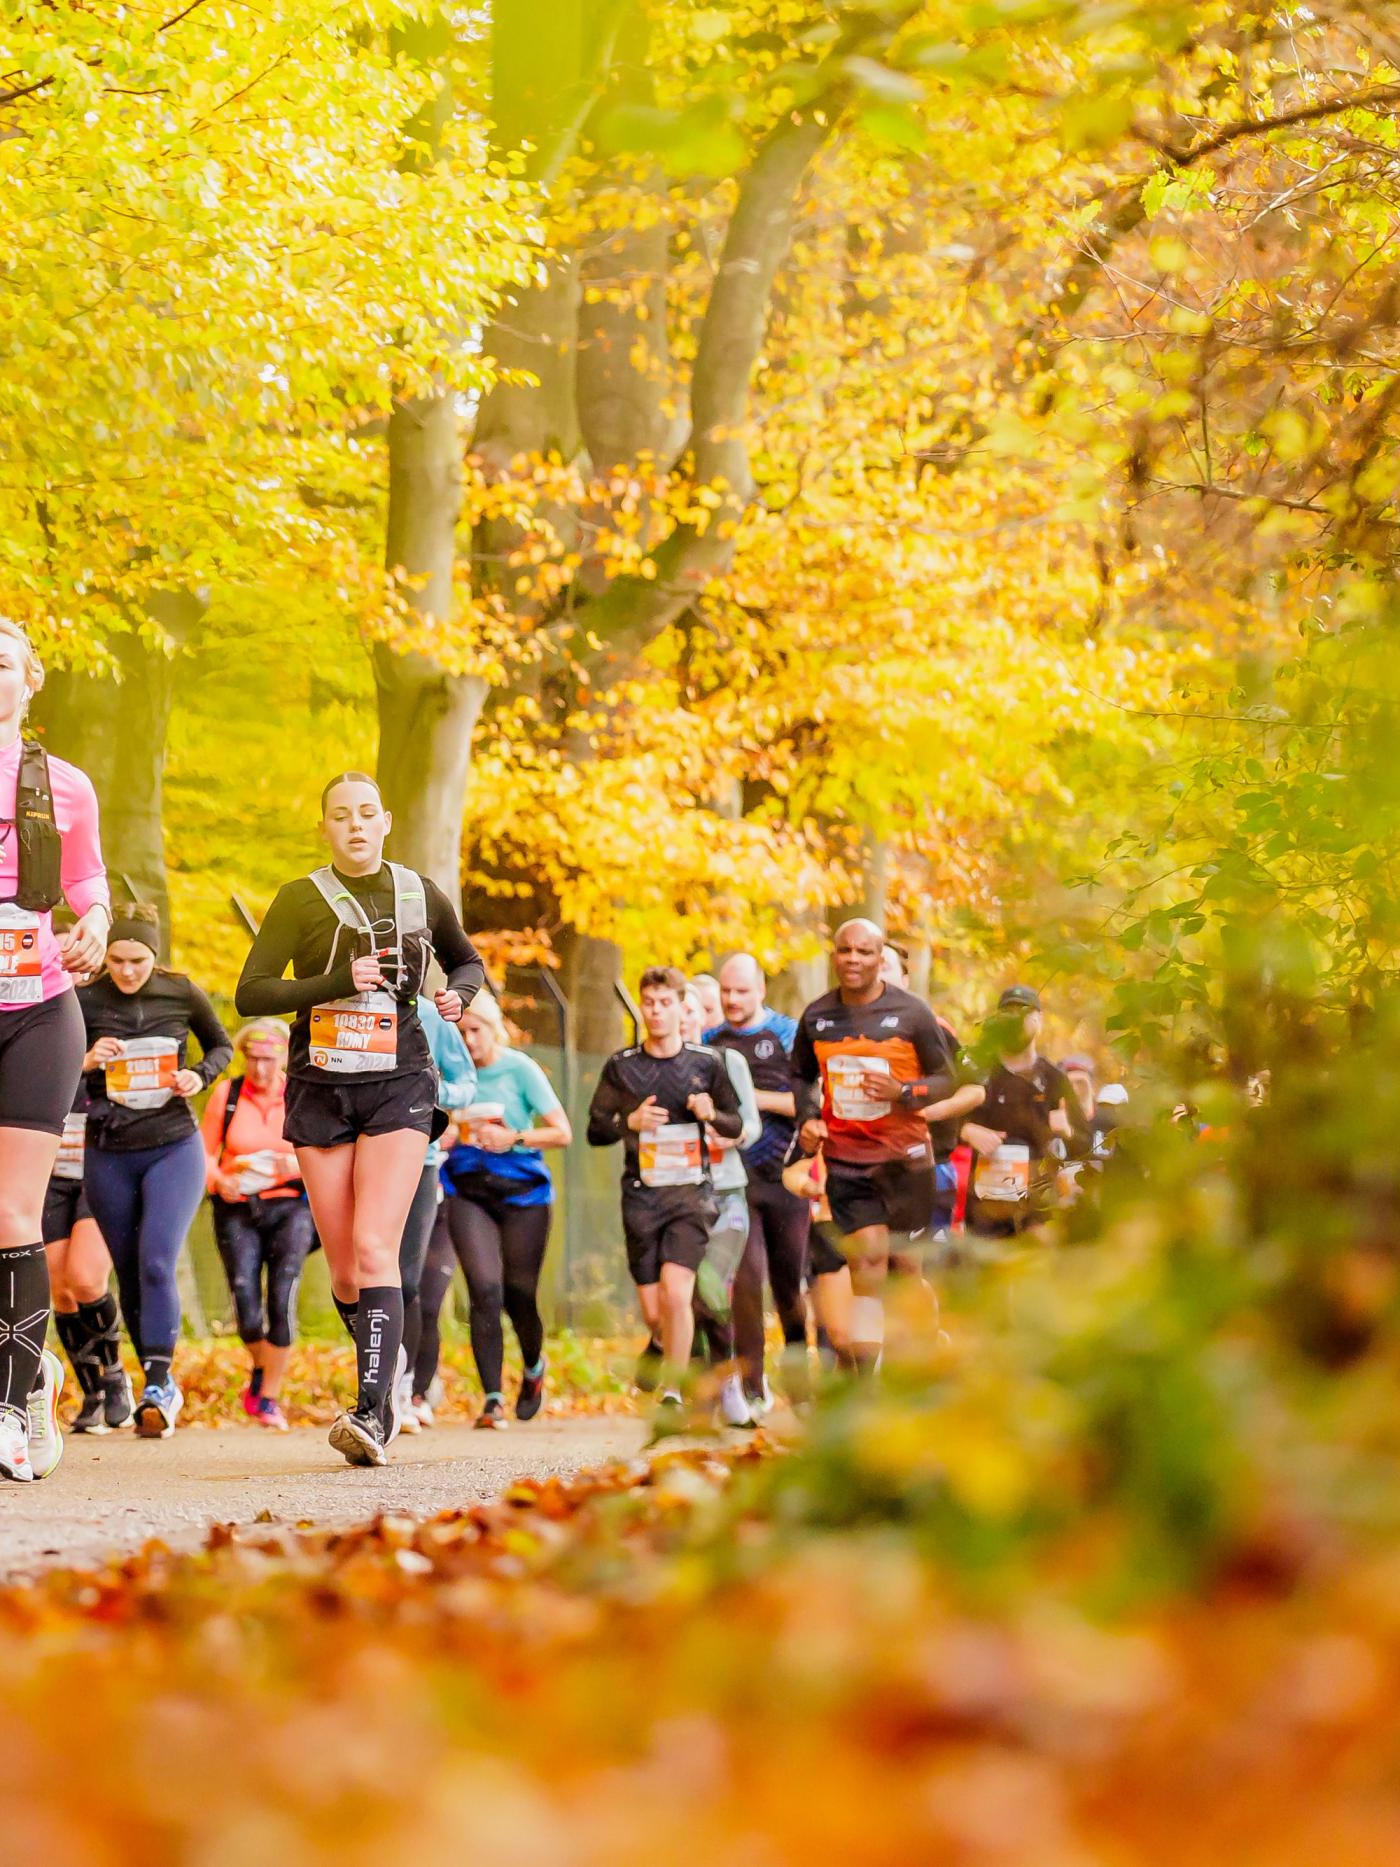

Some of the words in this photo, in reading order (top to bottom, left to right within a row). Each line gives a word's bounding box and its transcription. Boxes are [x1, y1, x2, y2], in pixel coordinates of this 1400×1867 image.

[333, 1013, 376, 1031] 10830
[336, 1031, 371, 1049] ROMY
[363, 1309, 390, 1384] kalenji
